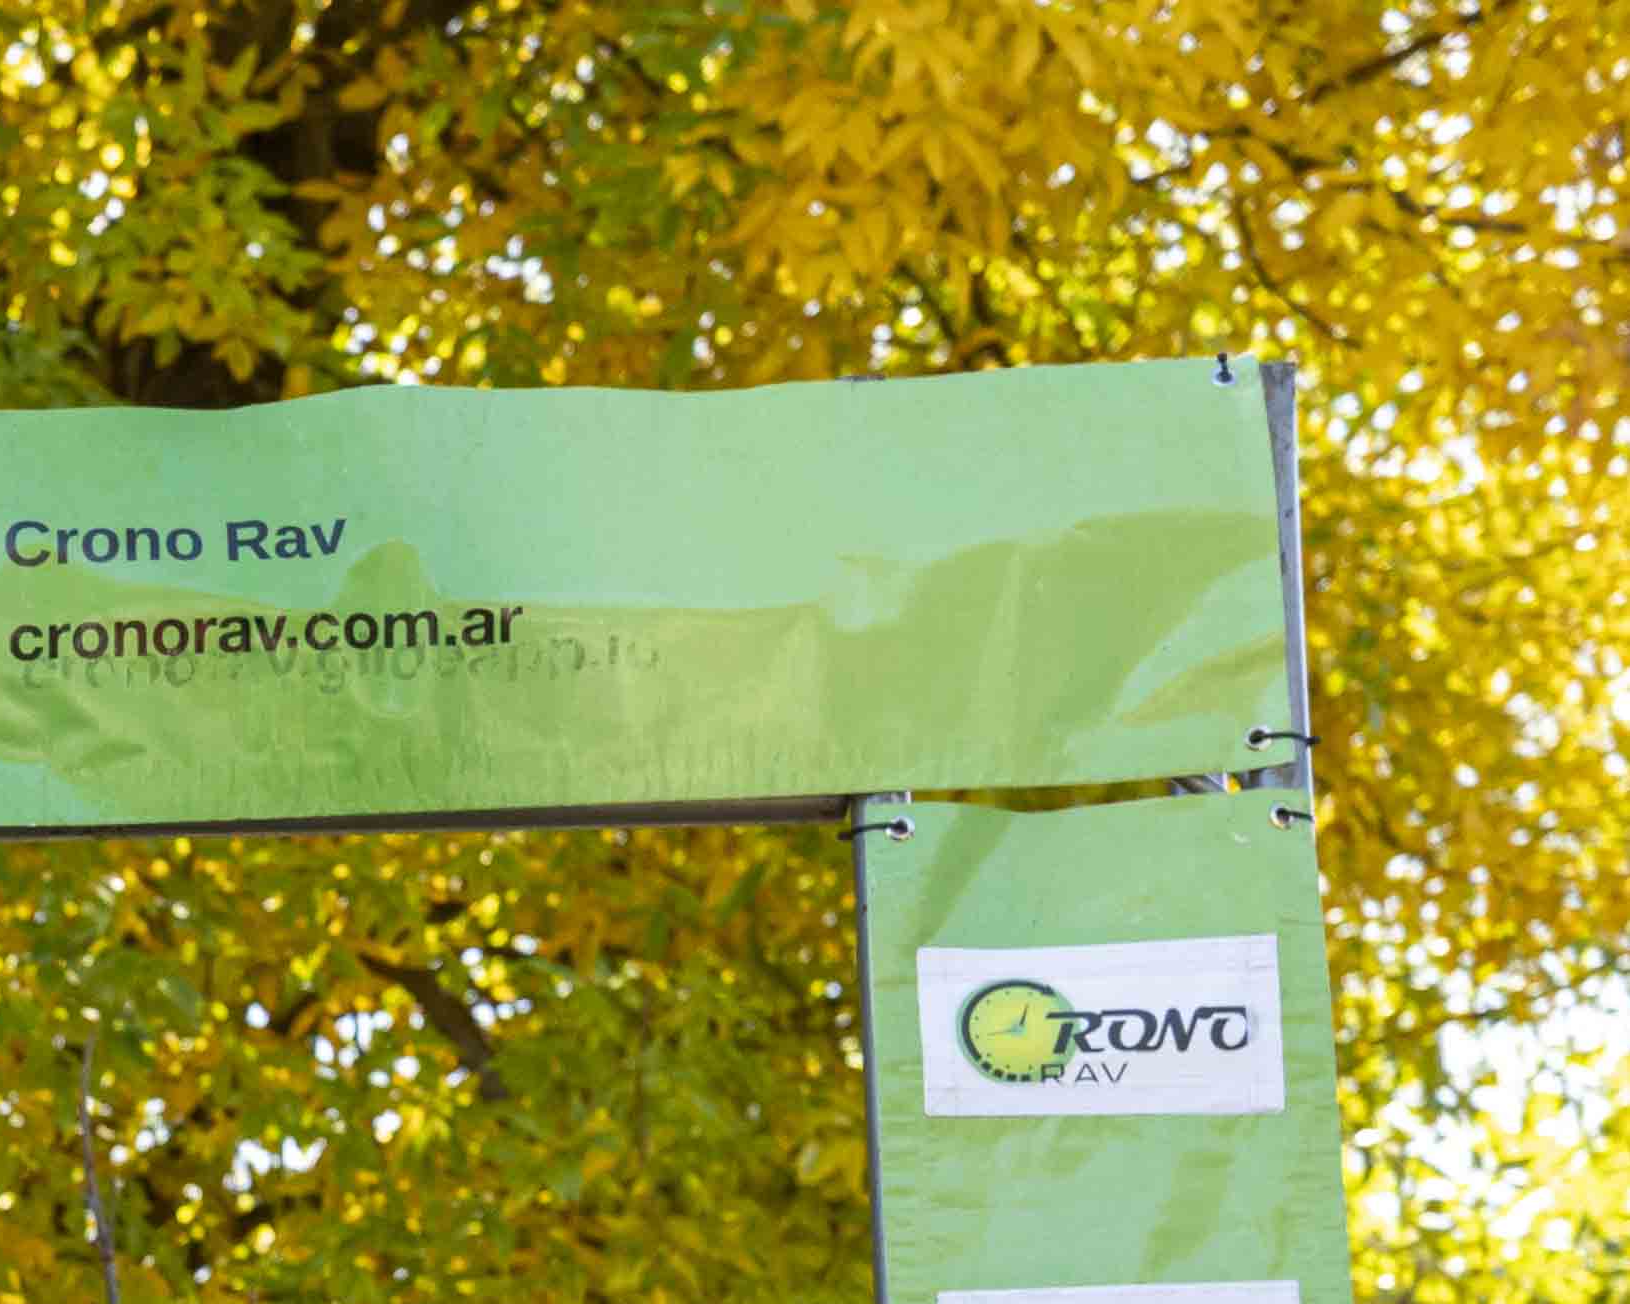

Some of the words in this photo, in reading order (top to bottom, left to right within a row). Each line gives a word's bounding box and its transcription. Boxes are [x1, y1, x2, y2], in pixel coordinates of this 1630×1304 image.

[4, 519, 205, 568] Crono
[226, 517, 347, 562] Rav
[9, 601, 524, 662] cronorav.com.ar
[1040, 1062, 1129, 1084] RAV
